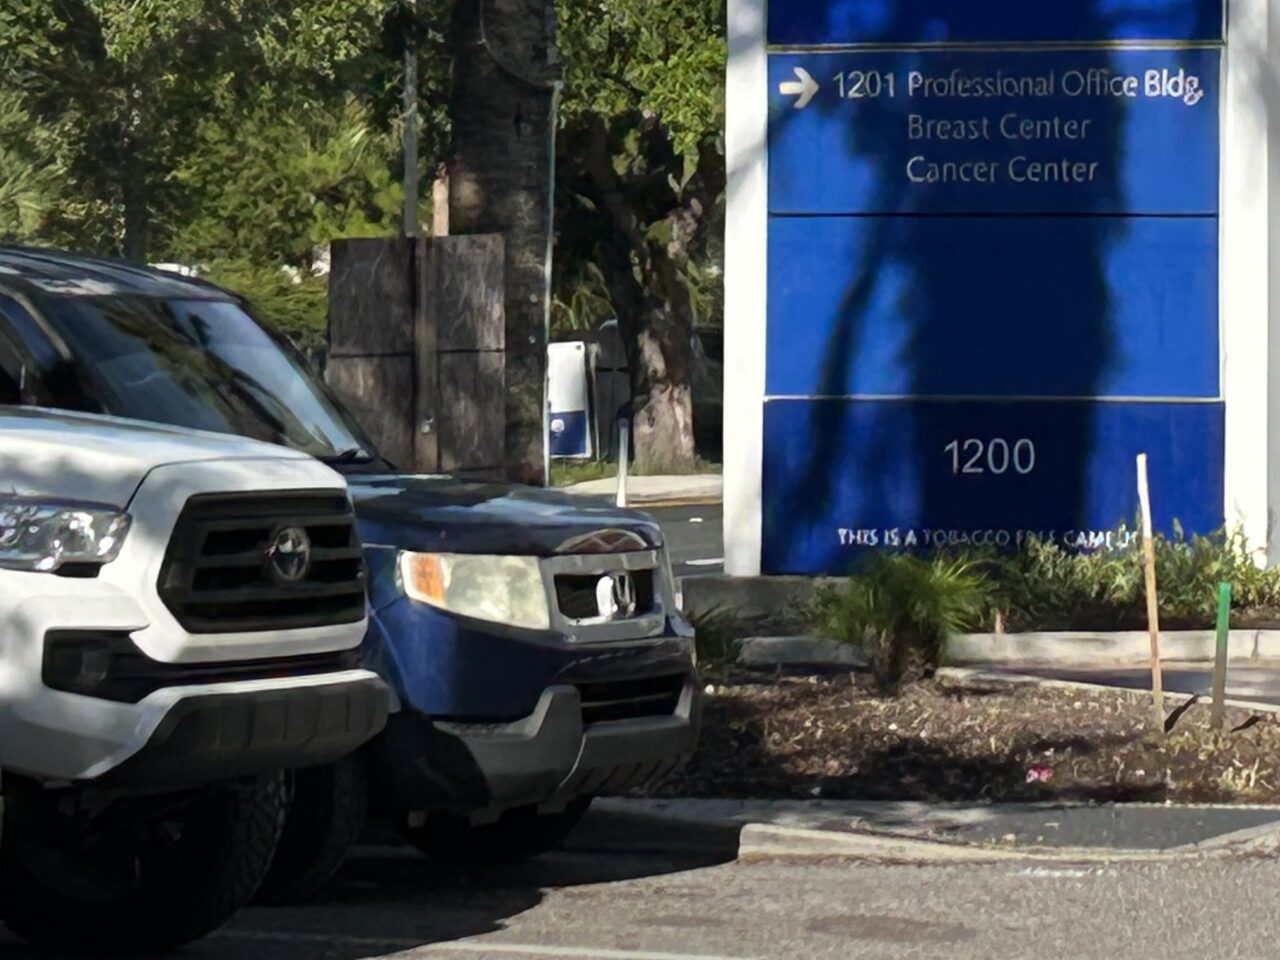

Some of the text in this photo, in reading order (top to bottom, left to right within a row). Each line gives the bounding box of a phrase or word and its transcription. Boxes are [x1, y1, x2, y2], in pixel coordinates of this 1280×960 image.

[833, 71, 895, 98] 1201
[908, 69, 1053, 97] Professional
[1062, 69, 1137, 97] Office
[908, 113, 1090, 140] Breast Center
[906, 155, 1098, 183] Cancer Center
[944, 437, 1036, 475] 1200
[837, 528, 878, 546] THIS
[884, 528, 900, 546] IS
[904, 528, 918, 547] A
[923, 529, 1010, 547] TOBACCO
